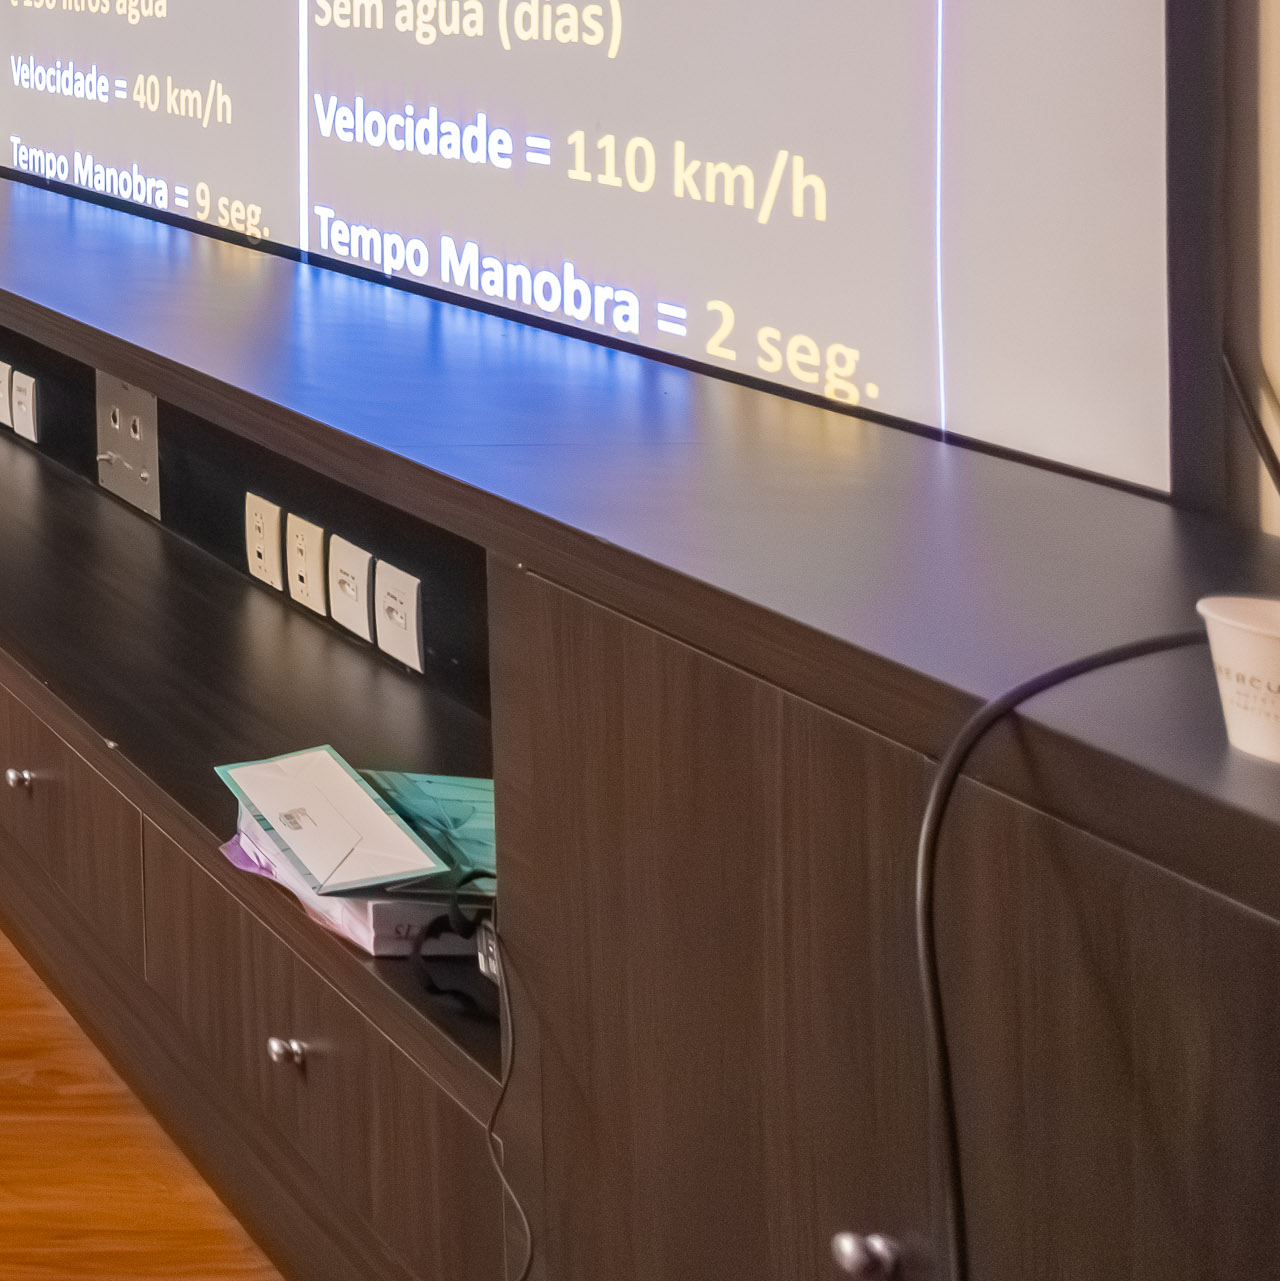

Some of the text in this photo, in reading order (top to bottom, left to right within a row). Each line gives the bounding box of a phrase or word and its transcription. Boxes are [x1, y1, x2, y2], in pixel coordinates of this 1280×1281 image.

[10, 54, 233, 128] Velocidade = 40 km/h
[9, 134, 270, 243] Tempo Manobra = 9 seg.
[313, 92, 827, 225] Velocidade = 110 km/h
[313, 204, 880, 406] Tempo Manobra = 2 seg.
